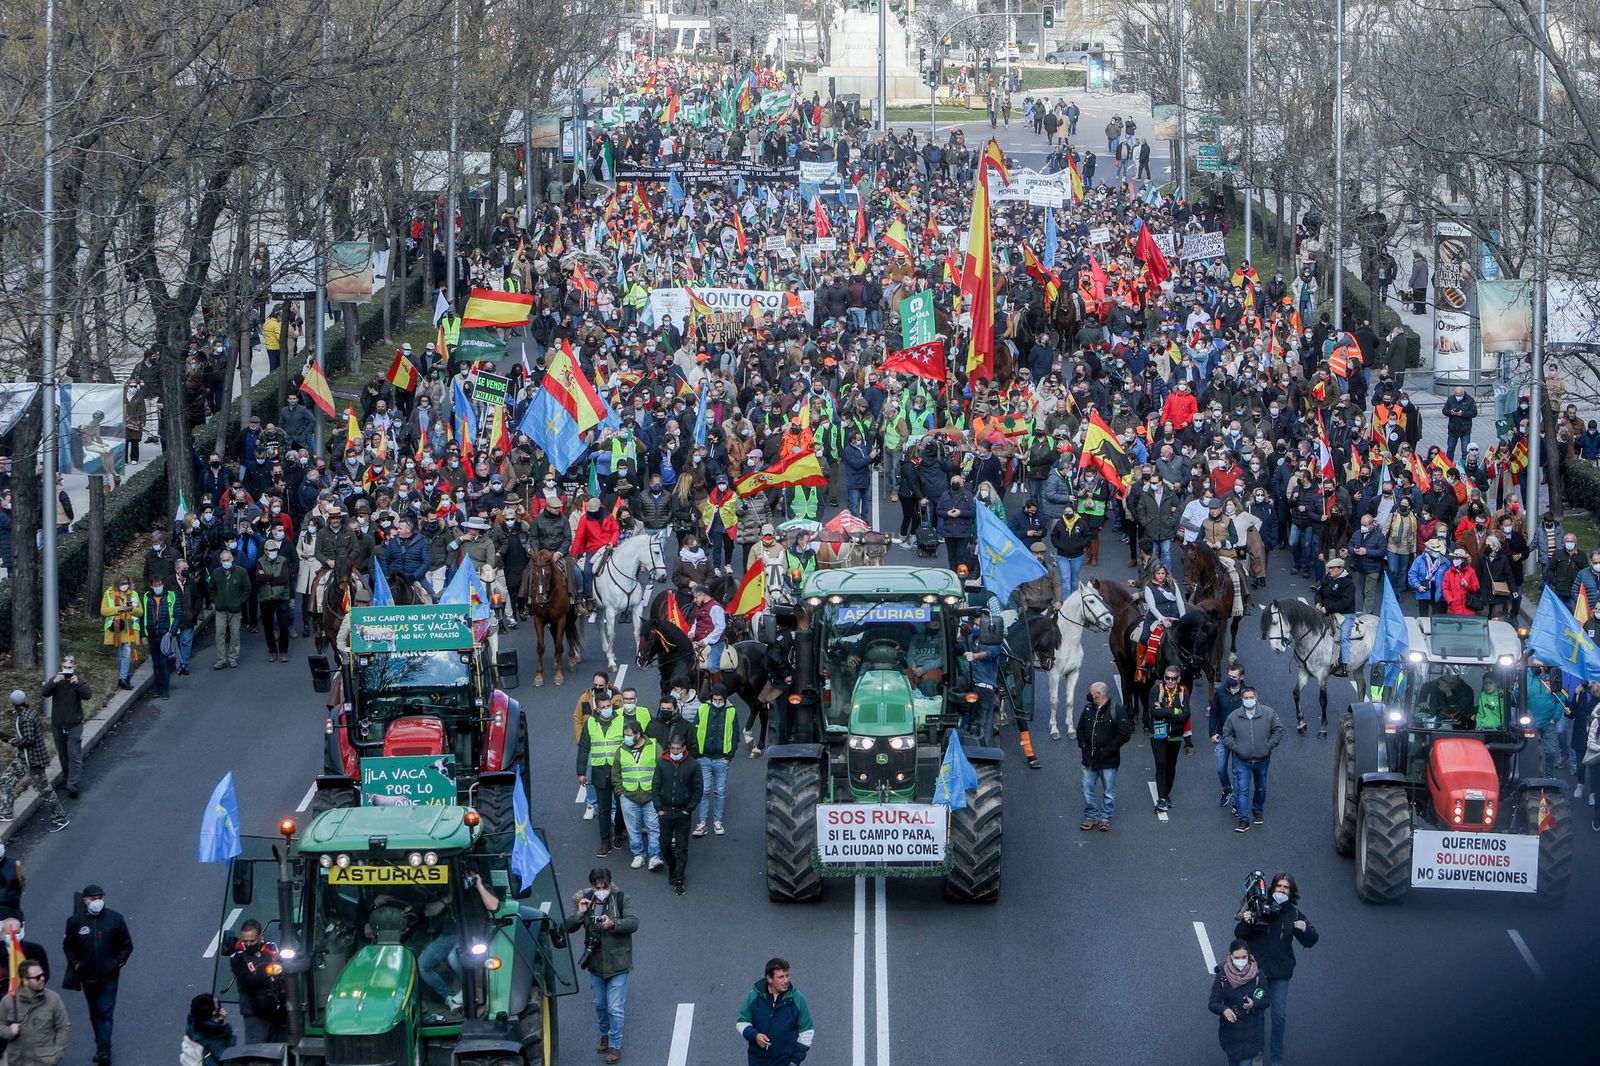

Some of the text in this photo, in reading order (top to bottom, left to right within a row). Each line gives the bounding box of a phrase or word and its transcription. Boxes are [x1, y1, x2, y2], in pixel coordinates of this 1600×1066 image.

[712, 333, 716, 342] Y
[478, 377, 506, 392] SE VENDE
[844, 606, 926, 620] ASTURIAS
[363, 624, 410, 632] ASTURIAS
[392, 768, 428, 780] VACA
[386, 784, 432, 794] POR LO
[828, 810, 935, 825] SOS RURAL
[828, 828, 935, 843] SI EL CAMPO PARA,
[825, 843, 939, 856] LA CIUDAD NO COME
[1442, 836, 1506, 850] QUEREMOS
[1436, 852, 1510, 868] SOLUCIONES
[336, 868, 441, 882] ASTURIAS
[1417, 868, 1528, 884] NO SUBVENCIONES
